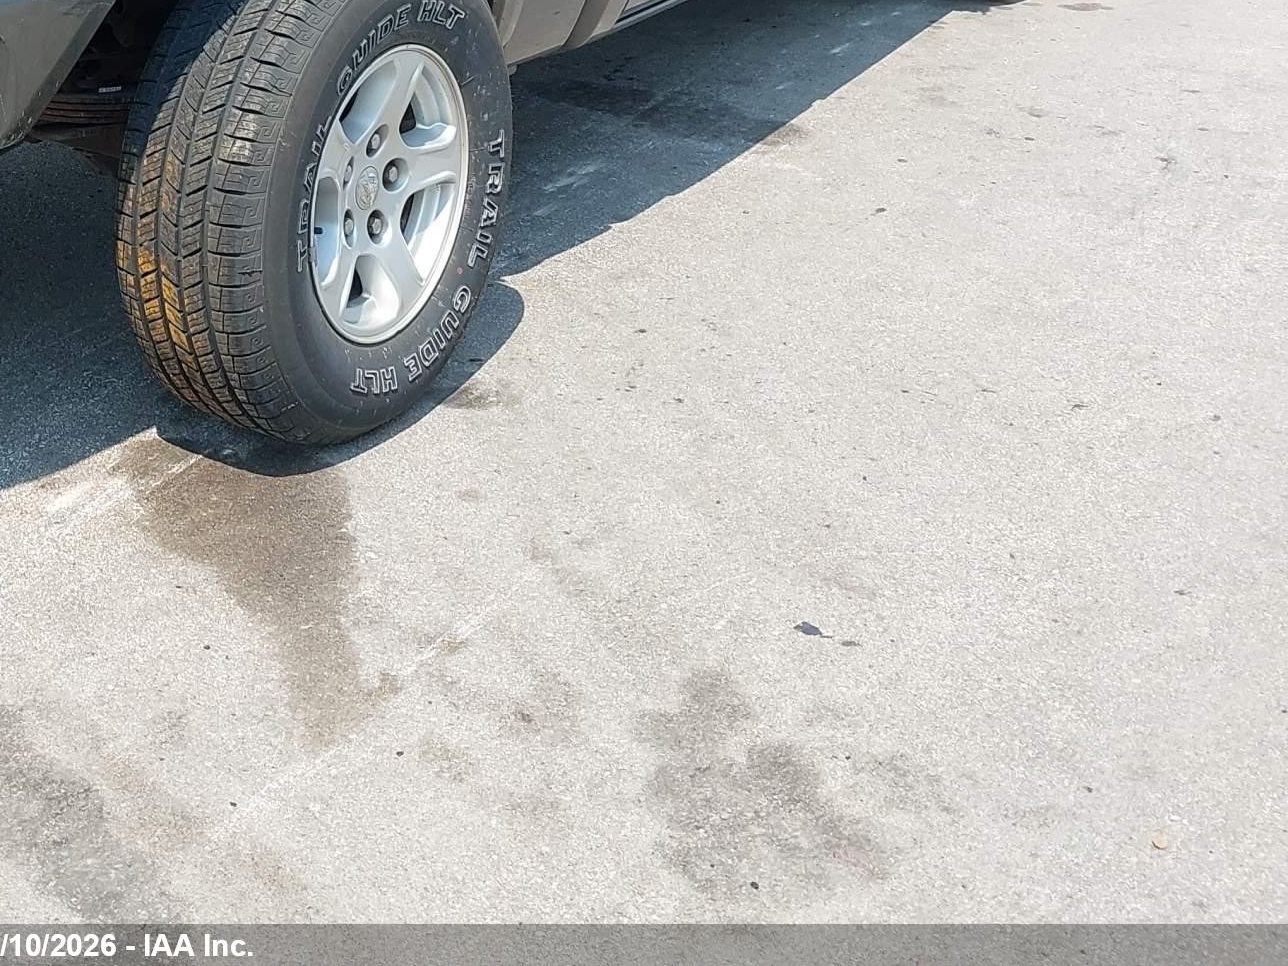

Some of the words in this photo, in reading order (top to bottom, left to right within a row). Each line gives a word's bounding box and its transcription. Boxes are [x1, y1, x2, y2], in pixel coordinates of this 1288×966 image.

[336, 2, 413, 98] GUIDE
[467, 128, 506, 269] TRAIL
[350, 365, 399, 394] HLT
[402, 284, 473, 383] GUIDE
